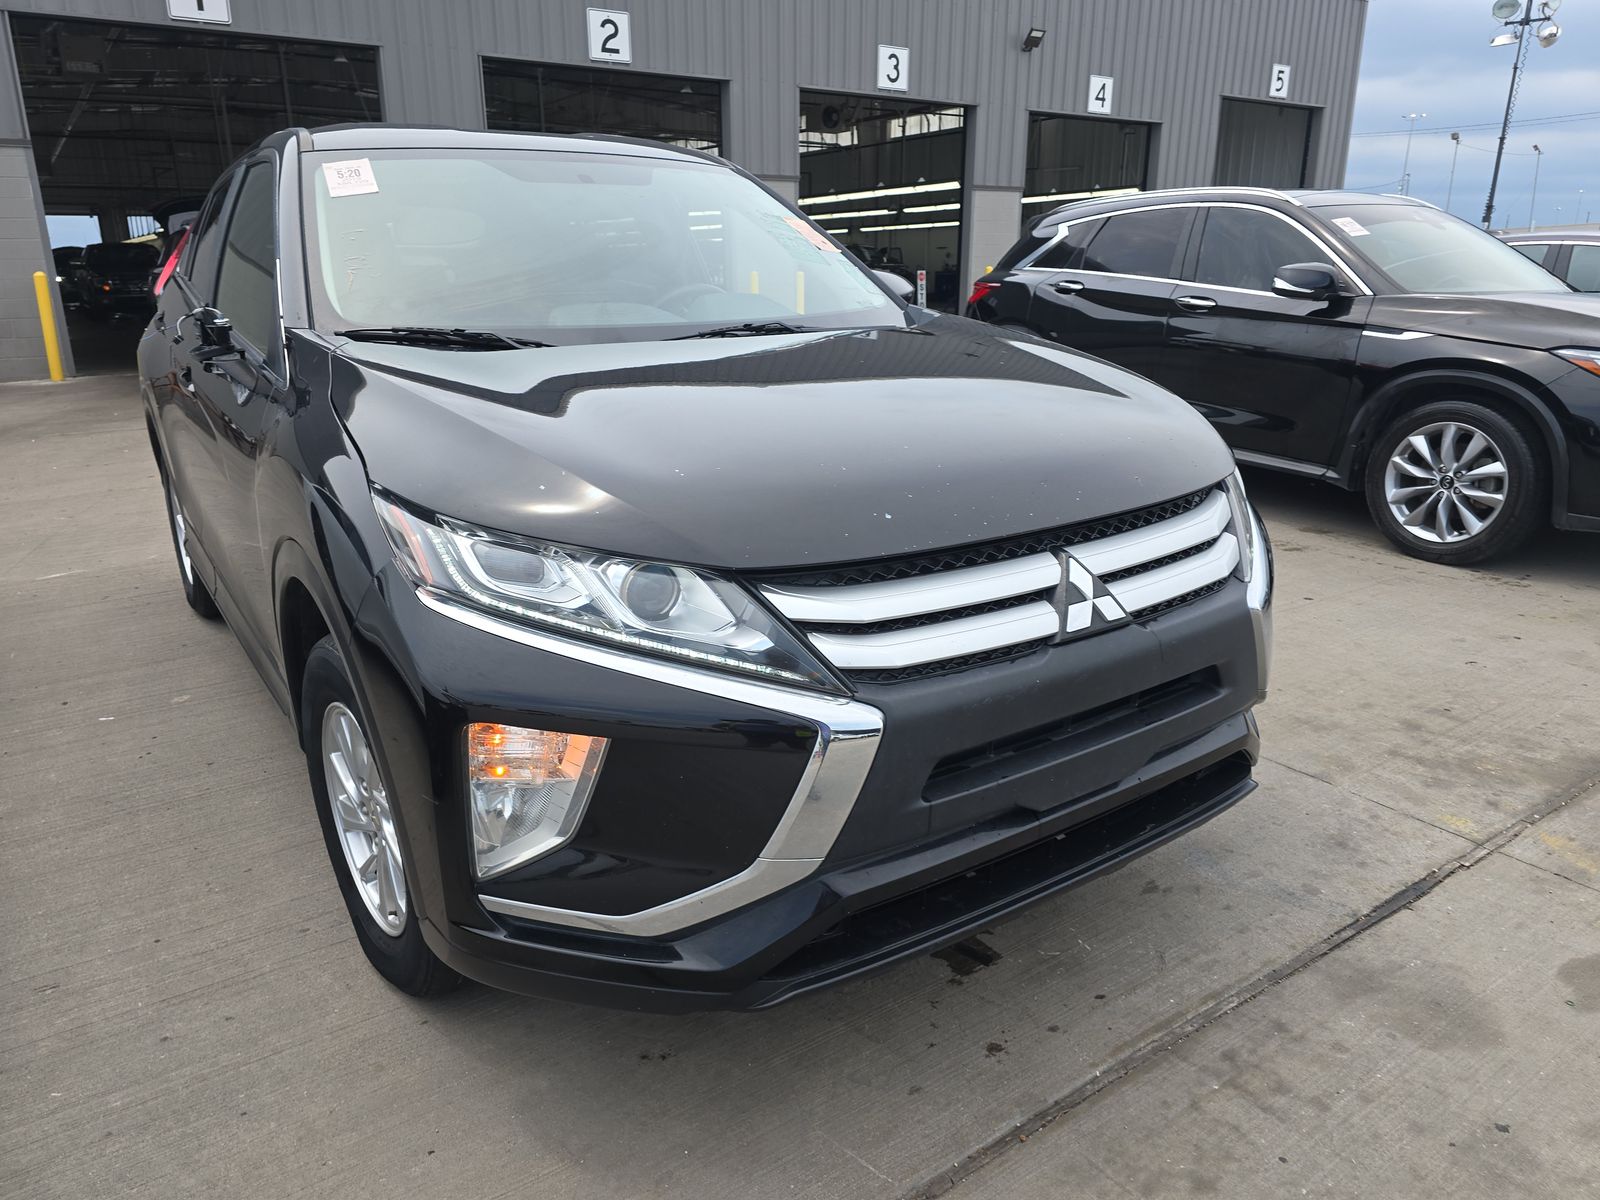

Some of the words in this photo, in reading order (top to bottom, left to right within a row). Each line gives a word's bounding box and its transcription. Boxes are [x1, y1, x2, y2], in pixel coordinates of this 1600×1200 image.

[600, 18, 620, 54] 2
[887, 53, 900, 83] 3
[1275, 70, 1285, 92] 5
[1095, 83, 1106, 108] 4
[337, 168, 361, 179] 5:20
